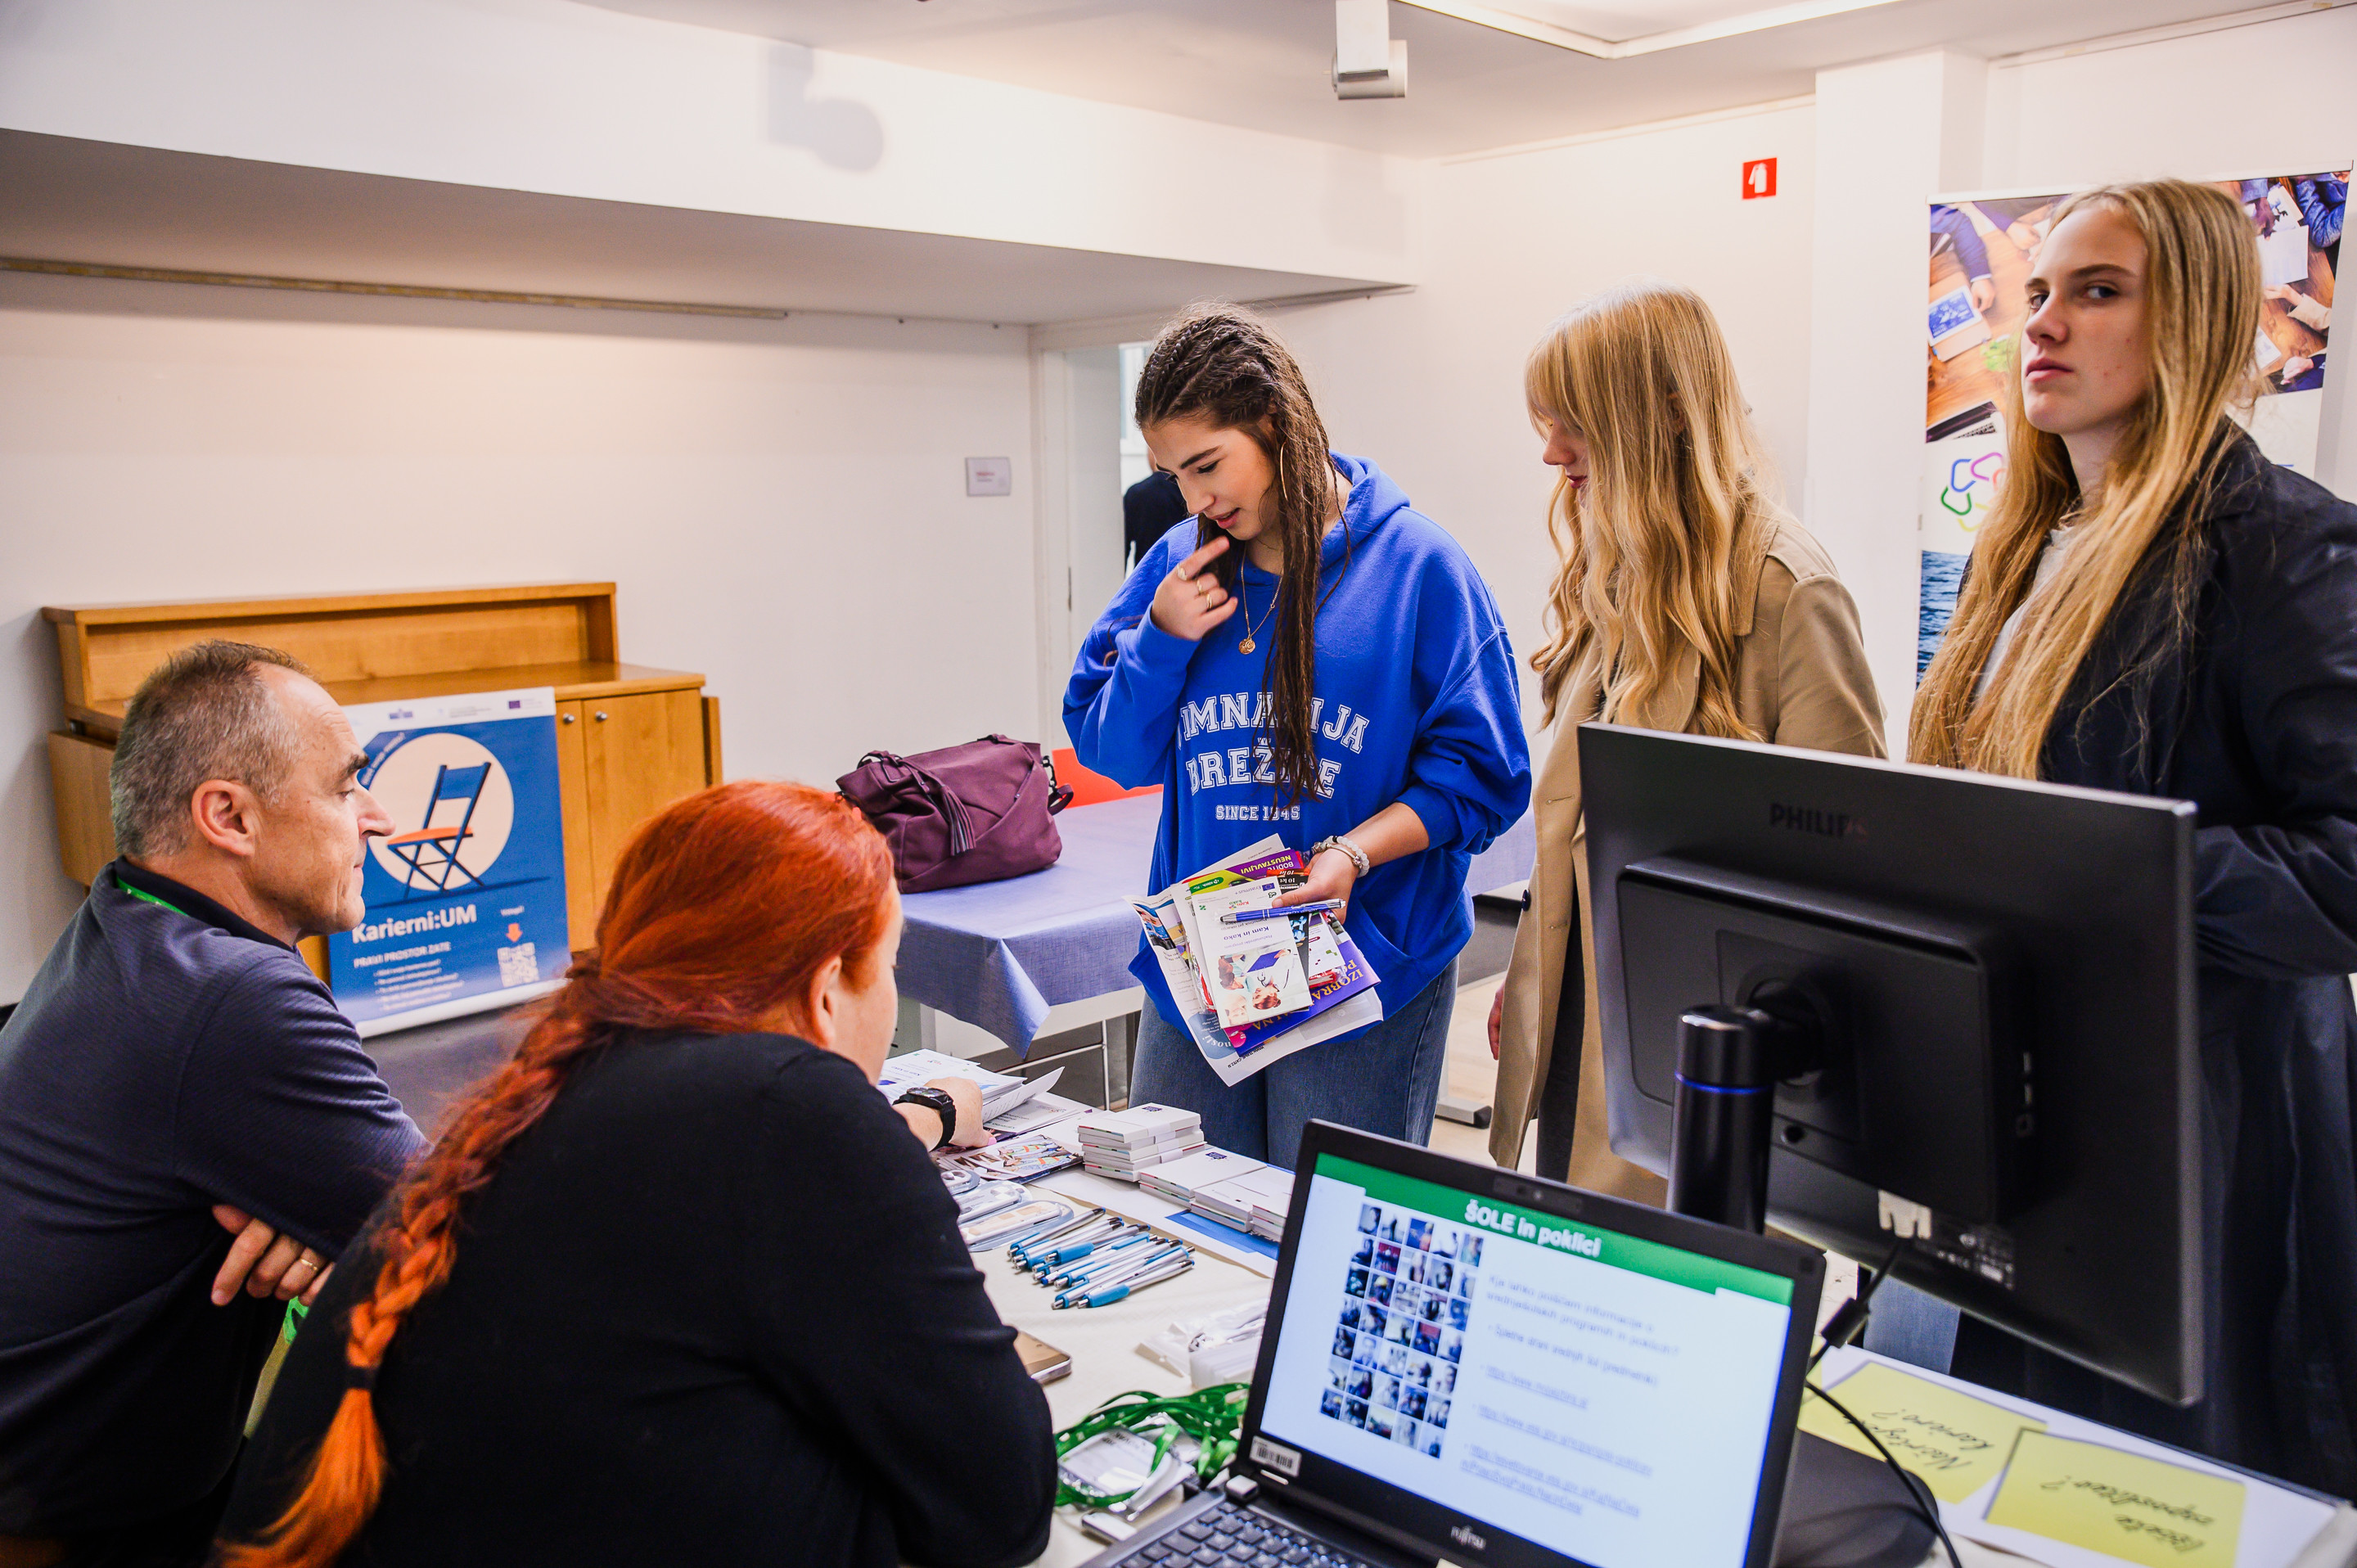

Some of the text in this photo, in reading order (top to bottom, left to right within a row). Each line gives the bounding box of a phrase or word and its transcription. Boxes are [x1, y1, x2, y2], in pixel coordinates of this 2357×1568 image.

[1177, 692, 1370, 755] IMNAIJA
[1186, 737, 1342, 800] BREŽE
[1215, 804, 1300, 821] SINCE 1945
[1769, 802, 1859, 840] PHILIP
[1240, 854, 1291, 875] NEUSTAVLJIVI
[1238, 885, 1262, 894] Erasmus
[352, 903, 477, 944] Karierni:UM
[1251, 926, 1269, 934] Kam
[1464, 1198, 1602, 1258] ŠOLE in poklici
